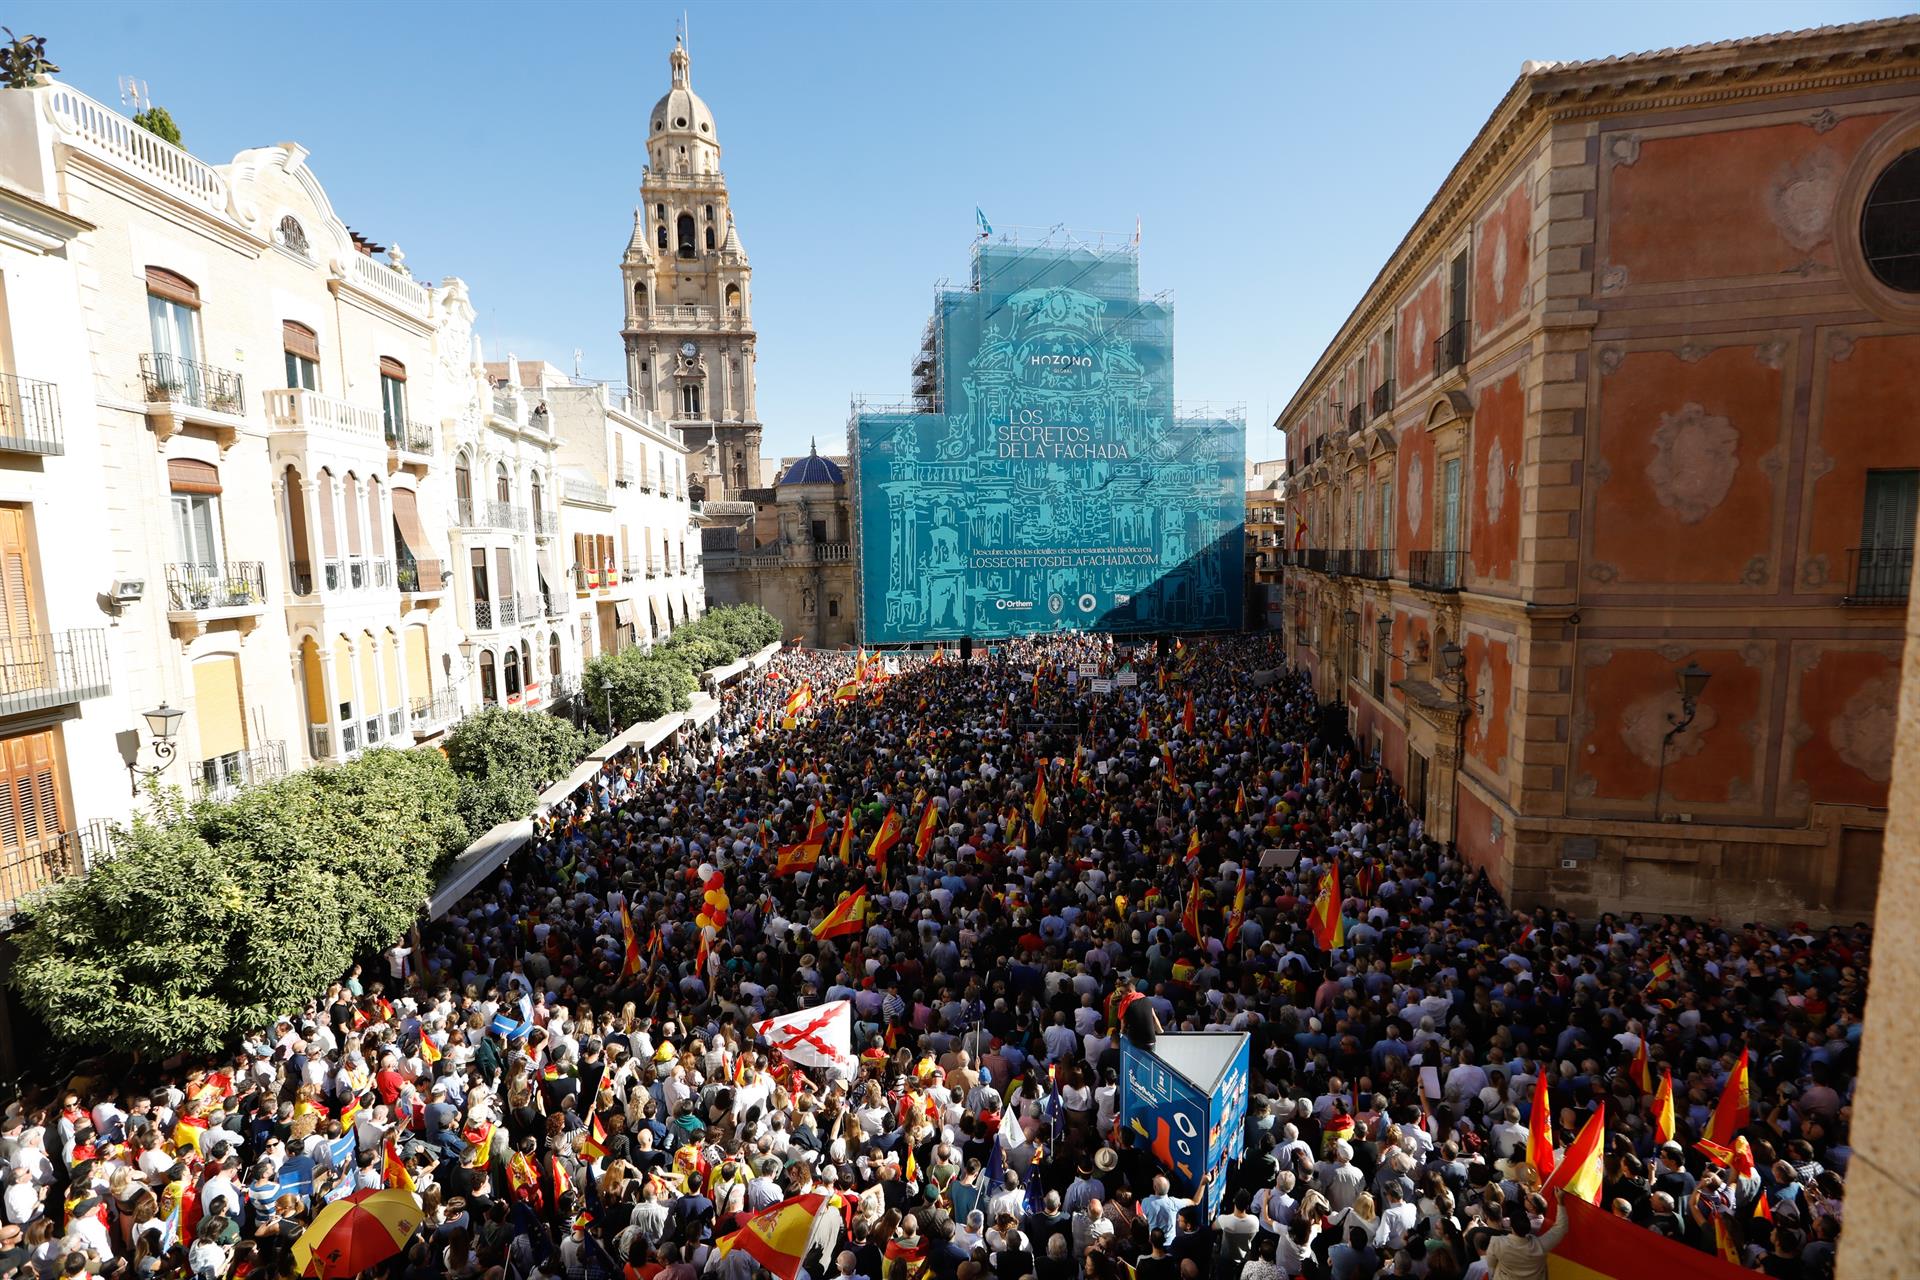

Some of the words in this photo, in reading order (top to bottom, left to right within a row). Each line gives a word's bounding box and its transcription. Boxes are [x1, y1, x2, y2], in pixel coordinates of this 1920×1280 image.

[1031, 355, 1092, 367] HOZONO
[1010, 409, 1043, 425] LOS
[998, 426, 1090, 447] SECRETOS
[1000, 442, 1021, 458] DE
[1024, 443, 1045, 458] LA
[1055, 443, 1128, 458] FACHADA
[1034, 547, 1057, 555] detalles
[1081, 546, 1117, 554] restauración
[970, 554, 1159, 569] LOSSECRETOSDELAFACHADA.COM
[1007, 600, 1033, 608] Orthem
